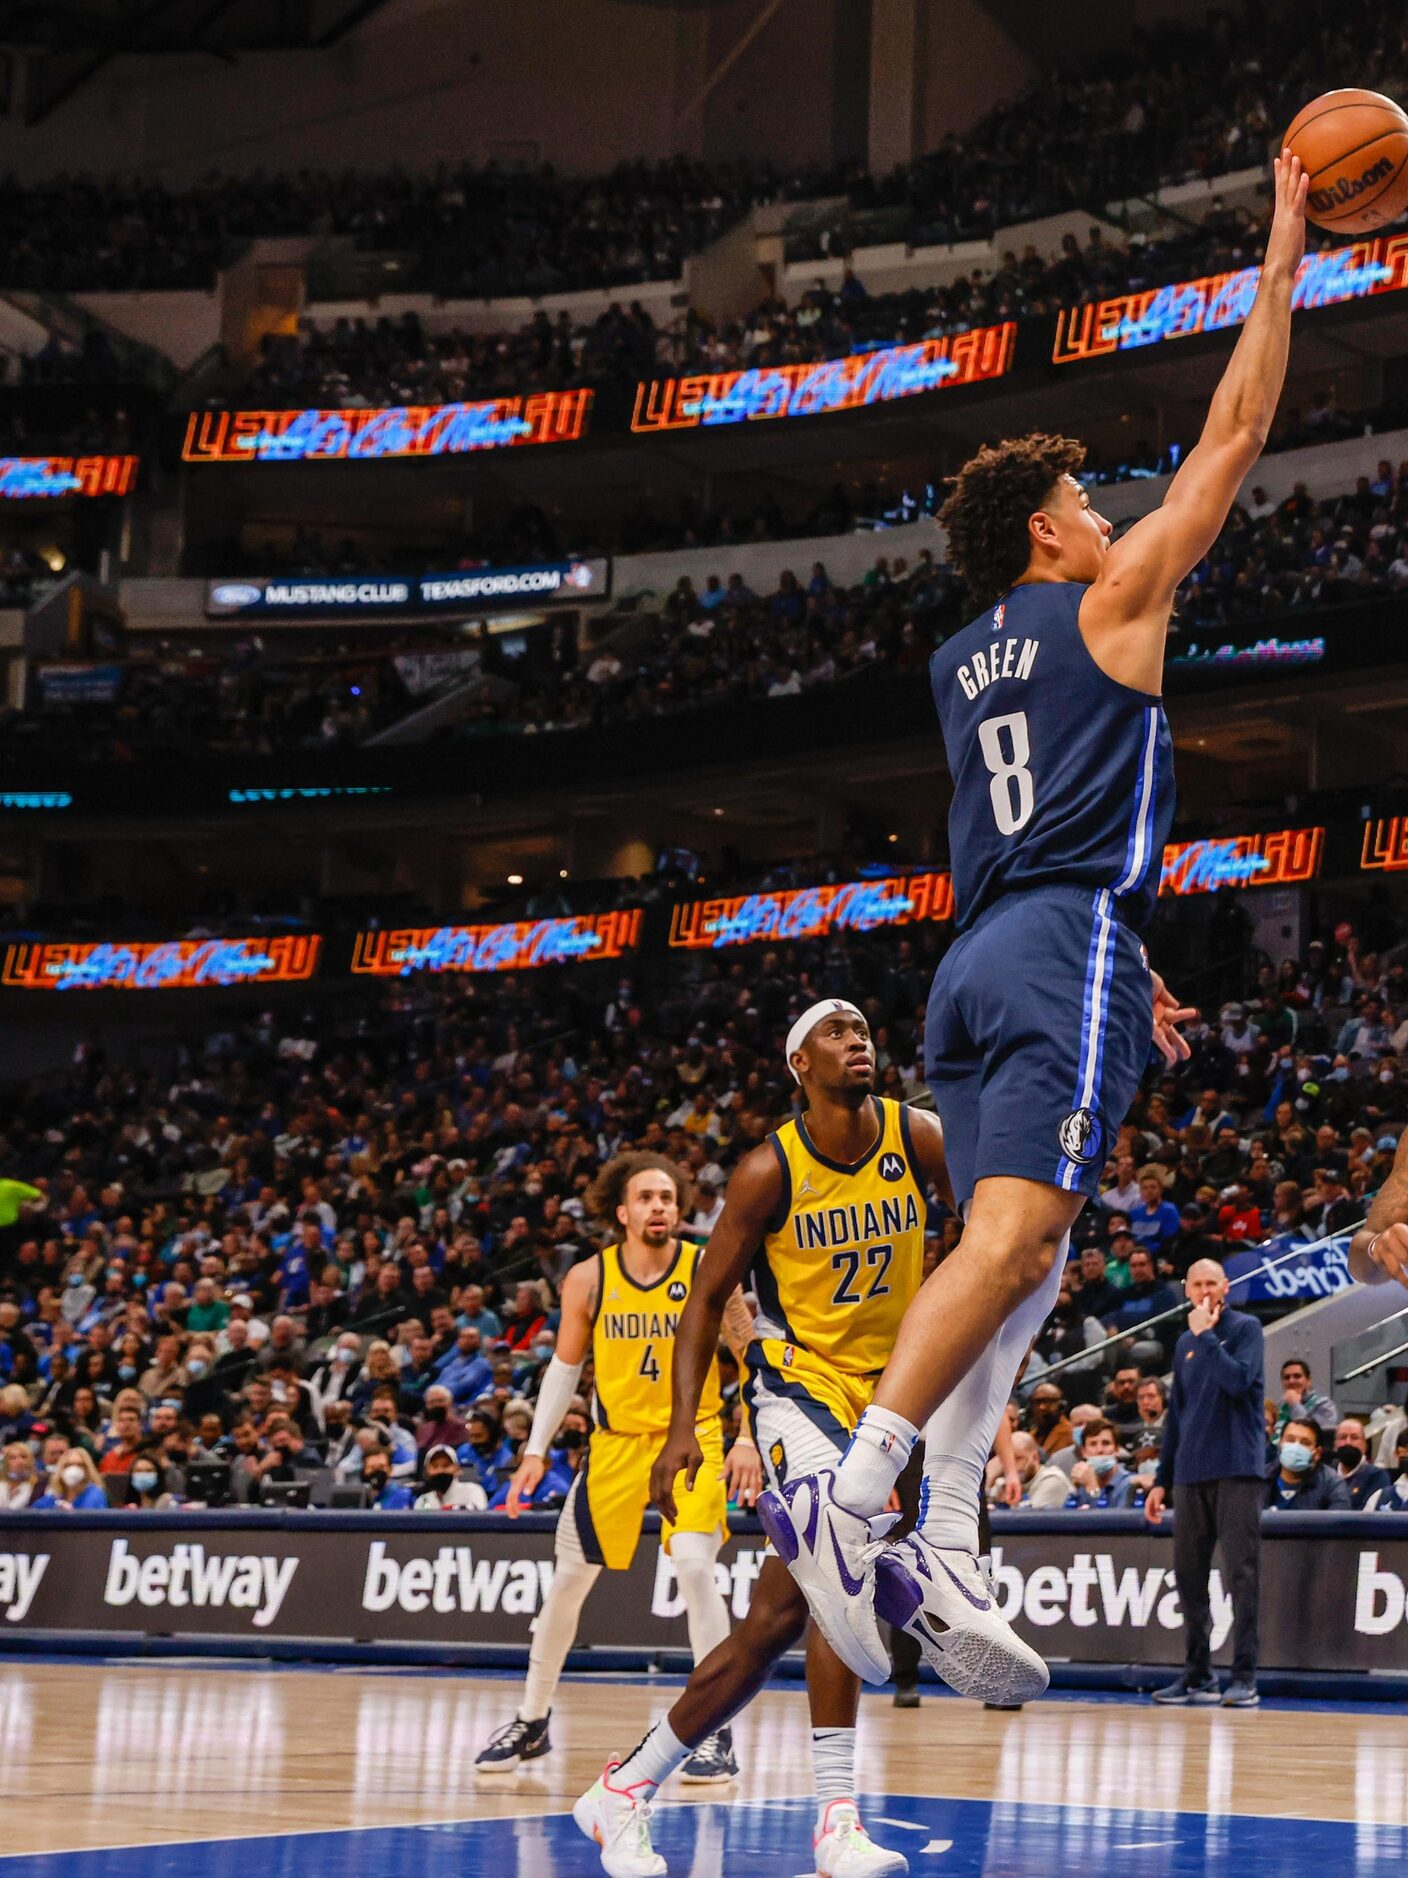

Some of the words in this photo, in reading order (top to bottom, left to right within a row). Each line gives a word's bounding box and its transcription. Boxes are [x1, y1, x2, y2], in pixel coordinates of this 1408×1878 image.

[957, 638, 1039, 700] GREEN
[978, 711, 1034, 836] 8
[794, 1194, 918, 1249] INDIANA
[831, 1243, 894, 1305] 22
[639, 1344, 660, 1382] 4
[104, 1538, 299, 1627] betway
